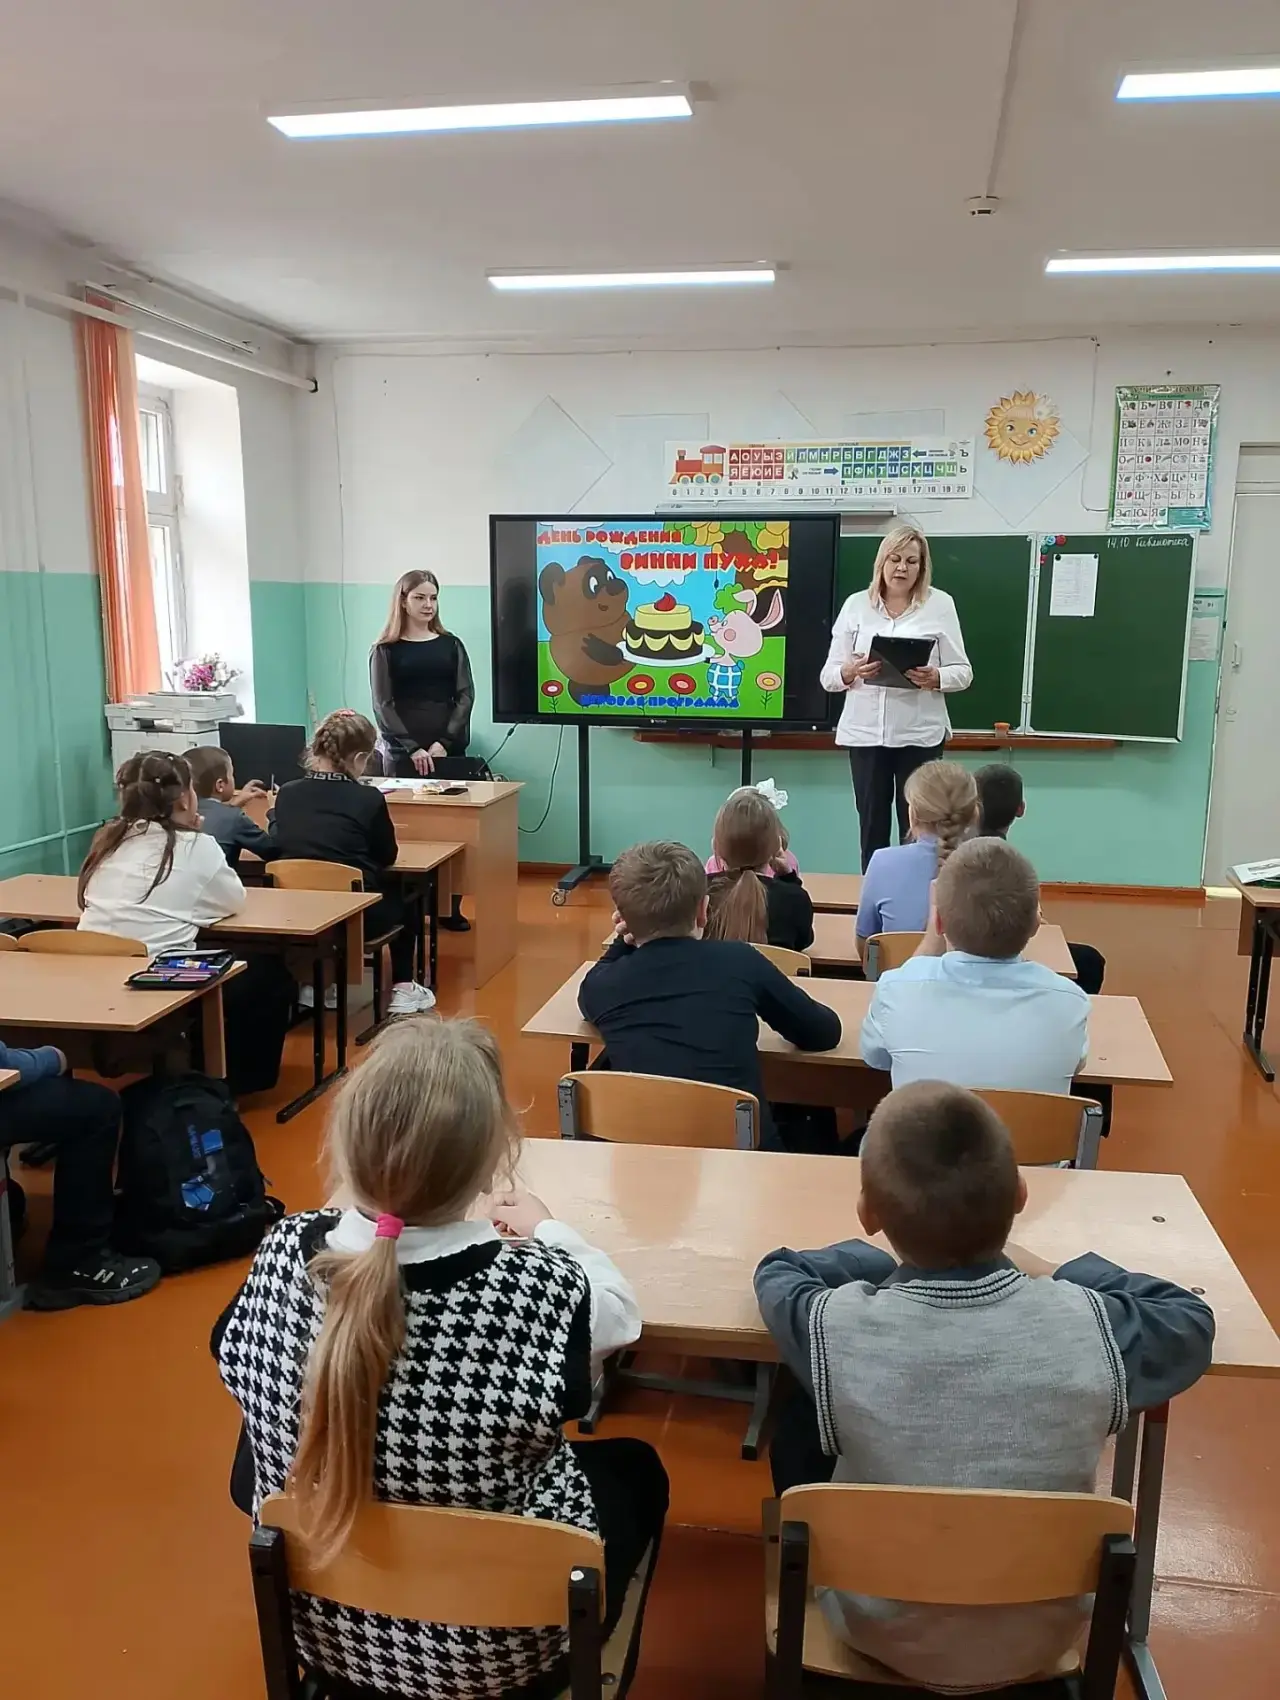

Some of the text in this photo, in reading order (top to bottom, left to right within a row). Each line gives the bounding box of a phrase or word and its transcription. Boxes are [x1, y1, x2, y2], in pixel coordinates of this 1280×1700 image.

[537, 530, 682, 545] ДЕНЬ РОЖДЕНИЯ
[620, 549, 779, 572] ВИННИ ПУХА!
